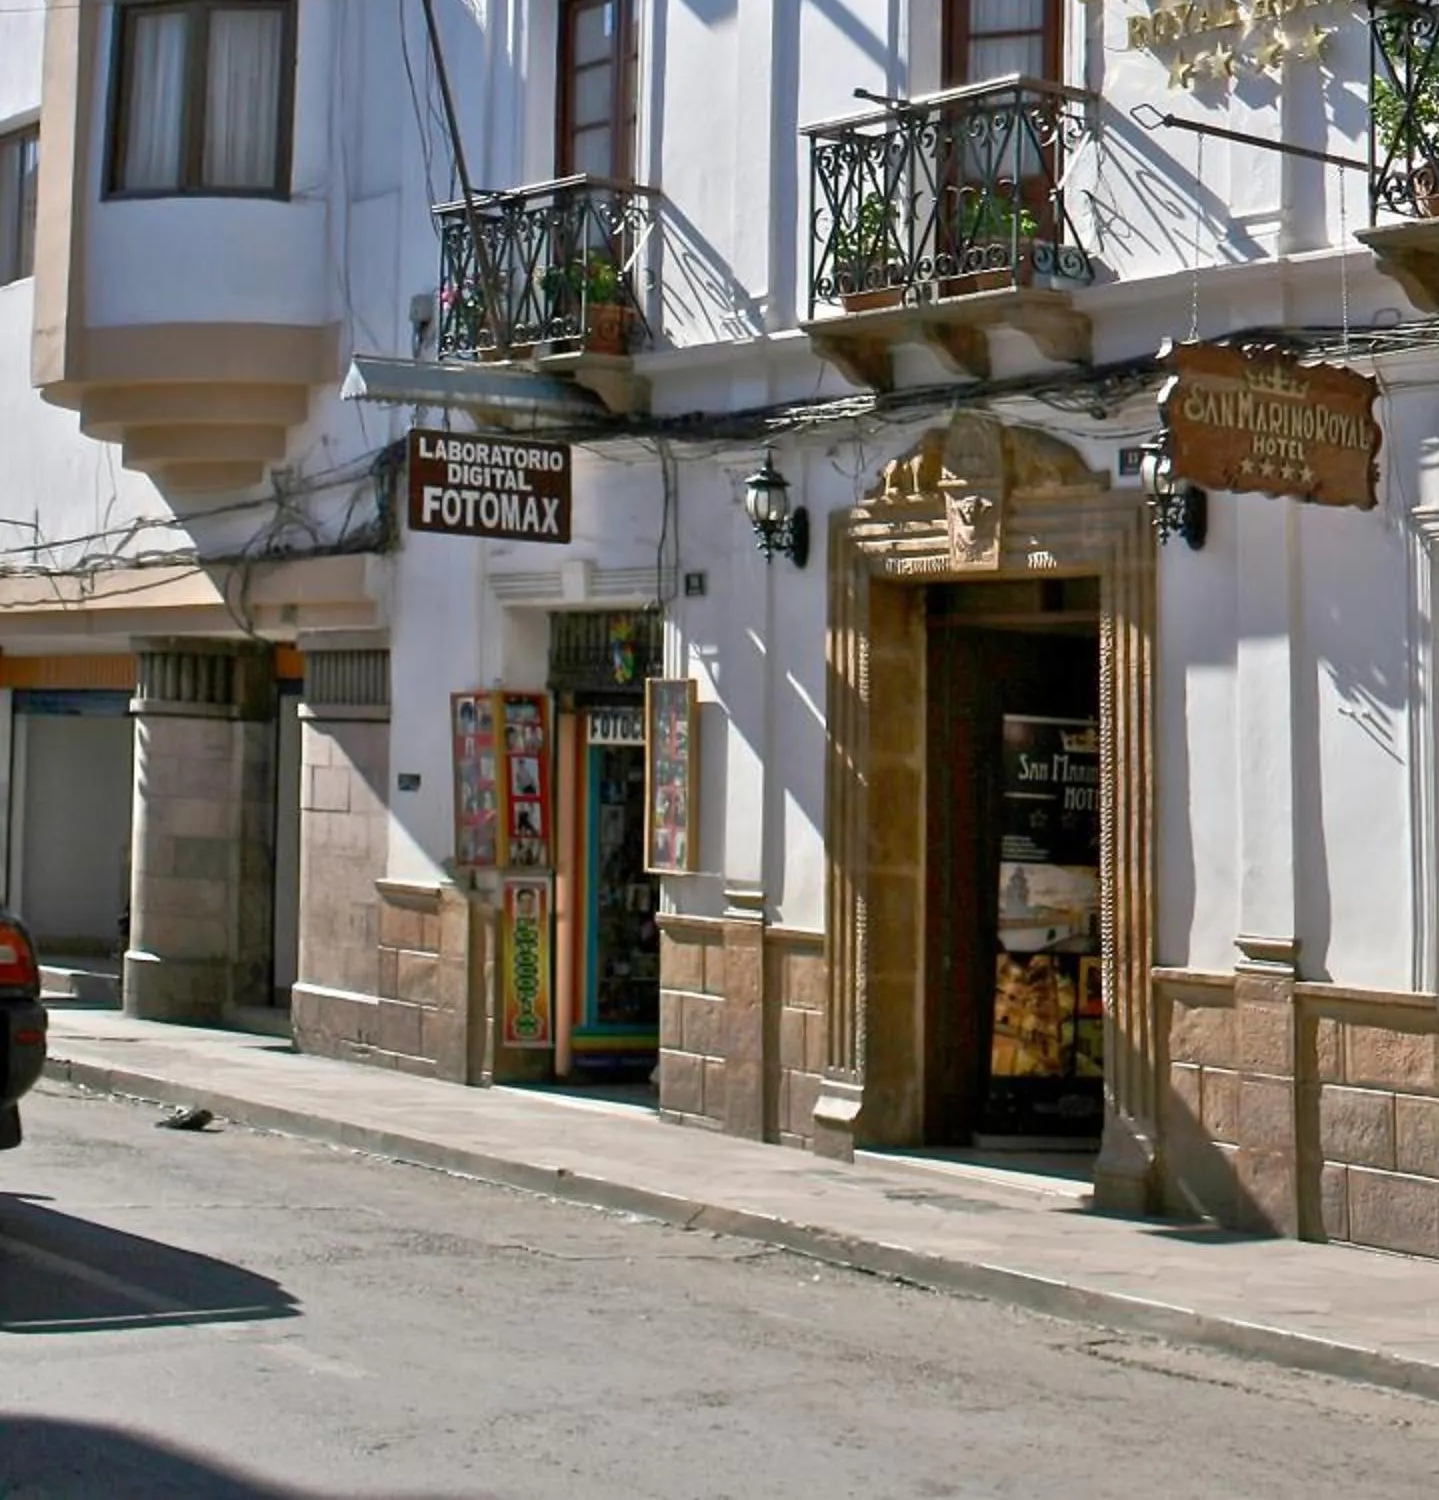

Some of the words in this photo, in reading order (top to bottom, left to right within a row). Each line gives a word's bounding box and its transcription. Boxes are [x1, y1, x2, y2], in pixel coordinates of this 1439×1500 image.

[1183, 384, 1236, 428] SAN
[1237, 390, 1315, 439] MARINO
[1315, 403, 1370, 450] ROYAL
[419, 436, 563, 472] LABORATORIO
[1253, 435, 1306, 460] HOTEL
[448, 463, 533, 491] DIGITAL
[422, 486, 560, 534] FOTOMAX
